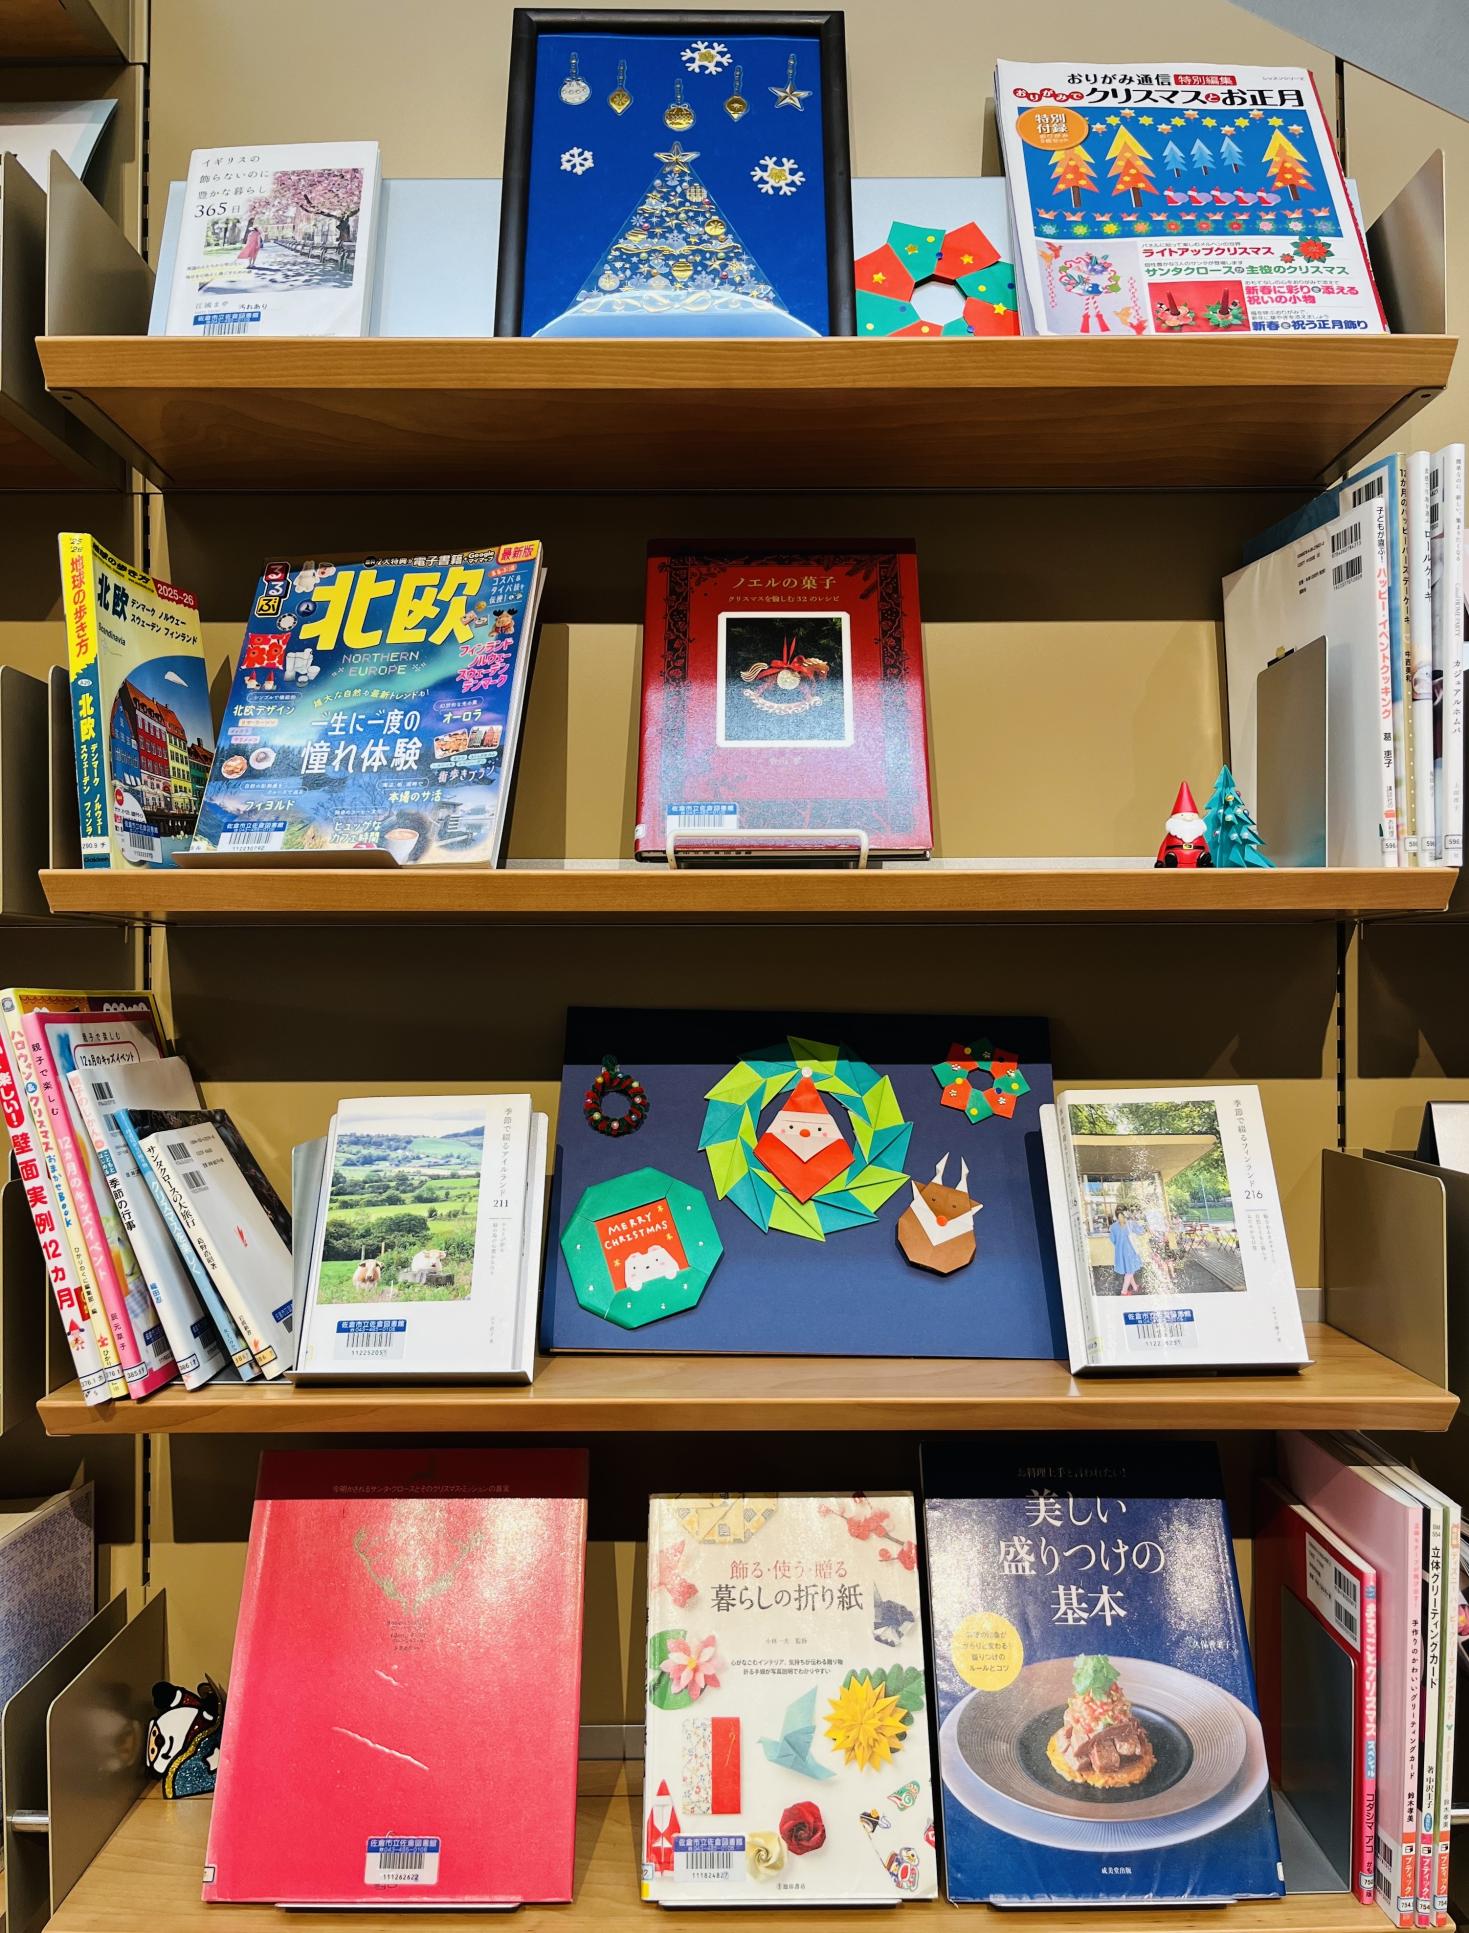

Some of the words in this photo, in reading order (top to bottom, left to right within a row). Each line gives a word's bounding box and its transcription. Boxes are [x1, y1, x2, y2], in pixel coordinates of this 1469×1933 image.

[1067, 73, 1172, 86] おりがみ通信
[1178, 75, 1233, 86] 特別編集
[1014, 88, 1085, 102] おりがみで
[1086, 87, 1304, 107] クリスマスとお正月
[1035, 113, 1066, 123] 特別
[1037, 124, 1068, 134] 付録
[202, 155, 260, 167] イギリスの
[1142, 246, 1275, 257] ライトアップクリスマス
[1247, 295, 1317, 305] 祝いの小物
[501, 544, 535, 561] 最新版
[257, 564, 285, 613] るるぶ
[732, 576, 837, 590] ノエルの菓子
[71, 554, 89, 657] 地球の歩き方
[97, 573, 130, 622] 北欧
[131, 598, 156, 616] デンマーク
[158, 611, 187, 626] ノルウェー
[298, 567, 486, 651] 北欧
[98, 623, 126, 646] Scandinavia
[130, 613, 162, 633] スウェーデン
[164, 627, 198, 645] フィンランド
[342, 651, 420, 664] NORTHERN
[459, 638, 514, 658] フィンランド
[348, 664, 407, 677] EUROPE
[461, 674, 508, 694] デンマーク
[78, 693, 96, 743] 北欧
[233, 704, 296, 716] 北欧デザイン
[442, 708, 482, 724] オーロラ
[311, 710, 421, 736] 一生に一度の
[300, 736, 423, 775] 憧れ体験
[245, 800, 296, 811] フィヨルド
[387, 790, 443, 803] 本場のサ活
[32, 1042, 59, 1117] 親子で楽しむ
[146, 1145, 197, 1229] サンタクロースの大旅行
[1244, 1190, 1263, 1200] 216
[109, 1176, 137, 1231] 季節の行事
[493, 1200, 509, 1208] 211
[608, 1211, 652, 1236] MERRY
[604, 1220, 668, 1250] CHRISTMAS
[1025, 1488, 1127, 1527] 美しい
[999, 1535, 1166, 1576] 盛りつけの
[710, 1583, 864, 1612] 暮らしの折り紙
[1050, 1584, 1128, 1627] 基本
